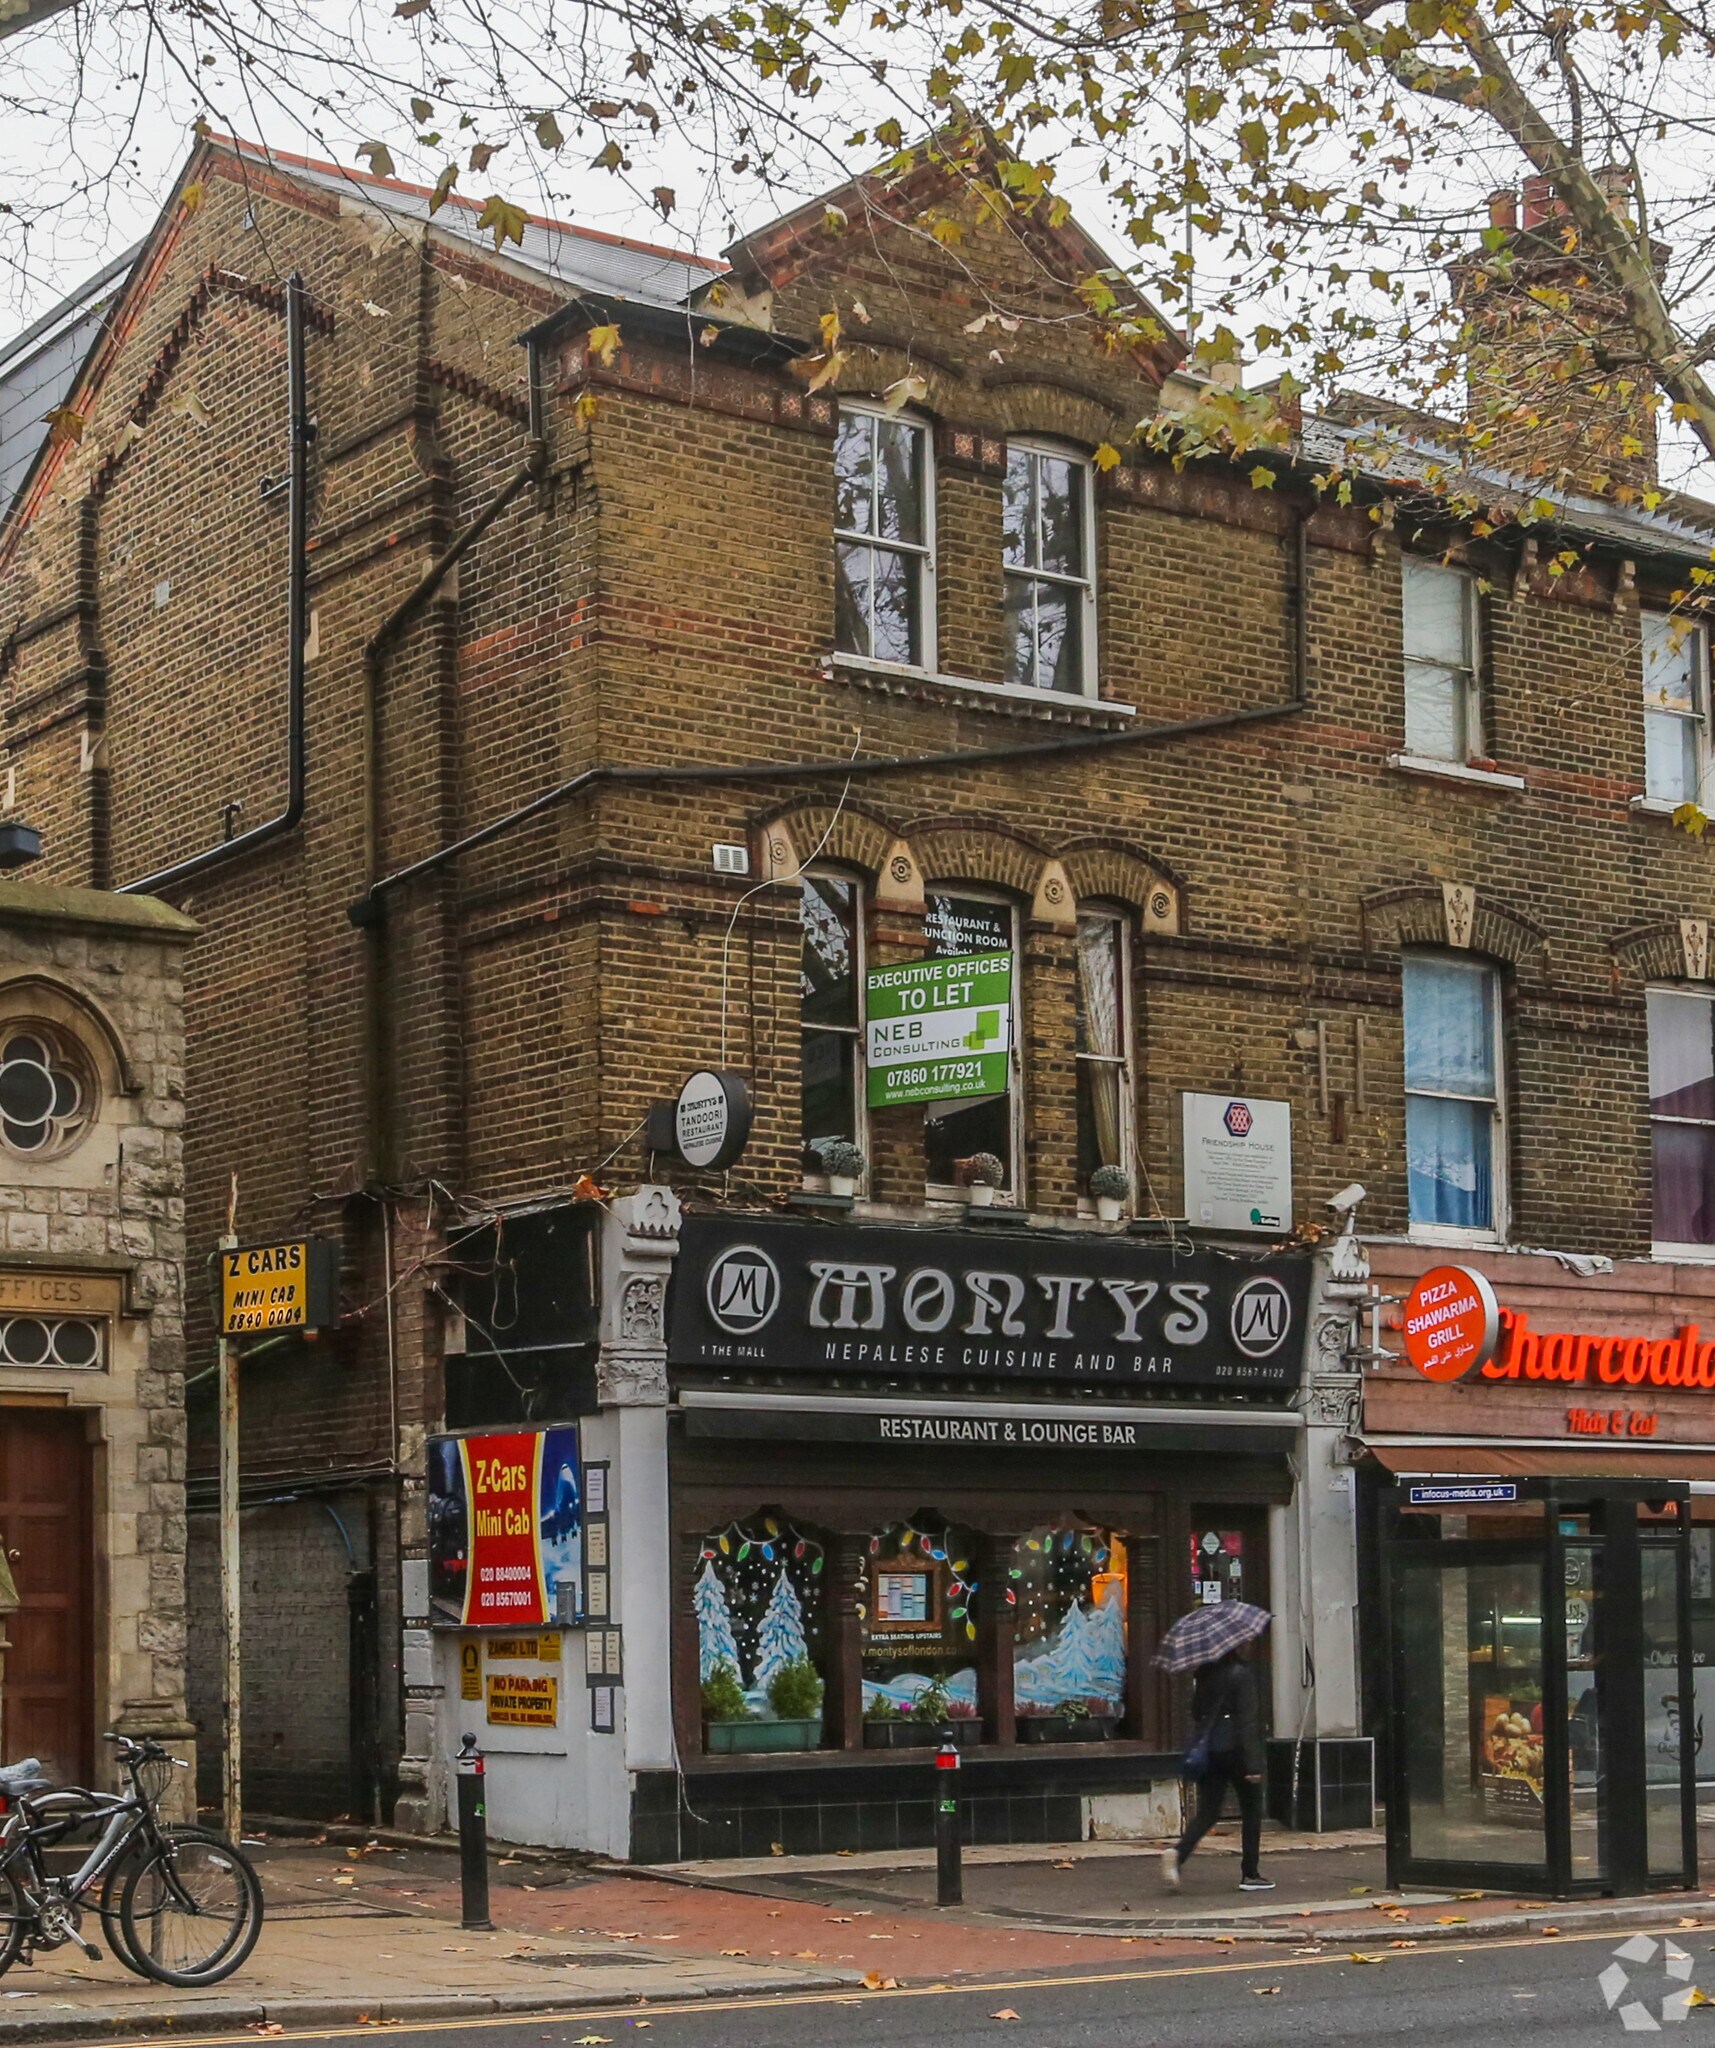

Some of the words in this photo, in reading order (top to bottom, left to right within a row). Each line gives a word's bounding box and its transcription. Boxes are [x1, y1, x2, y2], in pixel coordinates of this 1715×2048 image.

[926, 912, 990, 931] RESTAURANT
[993, 922, 1000, 932] &
[976, 934, 1008, 948] ROOM
[868, 966, 942, 990] EXECUTIVE
[946, 957, 1010, 979] OFFICES
[898, 988, 926, 1011] TO
[933, 982, 974, 1007] LET
[874, 1021, 923, 1044] NEB
[887, 1066, 928, 1088] 07860
[932, 1060, 982, 1082] 177921
[885, 1080, 986, 1100] www.nebconsulting.co.uk
[682, 1110, 722, 1127] TANDOORI
[682, 1122, 724, 1137] RESTAURANT
[1248, 1142, 1274, 1152] HOUSE
[229, 1254, 240, 1277] Z
[248, 1245, 300, 1274] CARS
[234, 1289, 265, 1308] MINI
[270, 1284, 296, 1304] CAB
[809, 1262, 1210, 1345] MONTYS
[1420, 1280, 1458, 1308] PIZZA
[228, 1312, 262, 1330] 8840
[269, 1306, 302, 1326] 0004
[1407, 1295, 1478, 1335] SHAWARMA
[1428, 1324, 1465, 1349] GRILL
[701, 1345, 706, 1355] 1
[712, 1345, 732, 1356] THE
[738, 1346, 765, 1358] MALL
[826, 1342, 946, 1364] NEPALESE
[963, 1348, 1057, 1369] CUISINE
[1074, 1354, 1116, 1371] AND
[1134, 1356, 1172, 1374] BAR
[1216, 1366, 1233, 1376] 020
[880, 1418, 998, 1442] RESTAURANT
[1004, 1423, 1016, 1442] &
[1022, 1423, 1098, 1443] LOUNGE
[1102, 1425, 1136, 1444] BAR
[1628, 1410, 1658, 1436] Eat
[476, 1458, 527, 1494] Z-Cars
[1422, 1488, 1504, 1499] infocus-media.org.uk
[476, 1509, 502, 1537] Mini
[505, 1508, 530, 1536] Cab
[480, 1568, 494, 1582] 020
[496, 1566, 532, 1582] 88400004
[481, 1592, 494, 1607] 020
[494, 1678, 507, 1691] NO
[508, 1678, 548, 1693] PARKING
[490, 1695, 516, 1709] PRIVATE
[518, 1696, 552, 1711] PROPERTY
